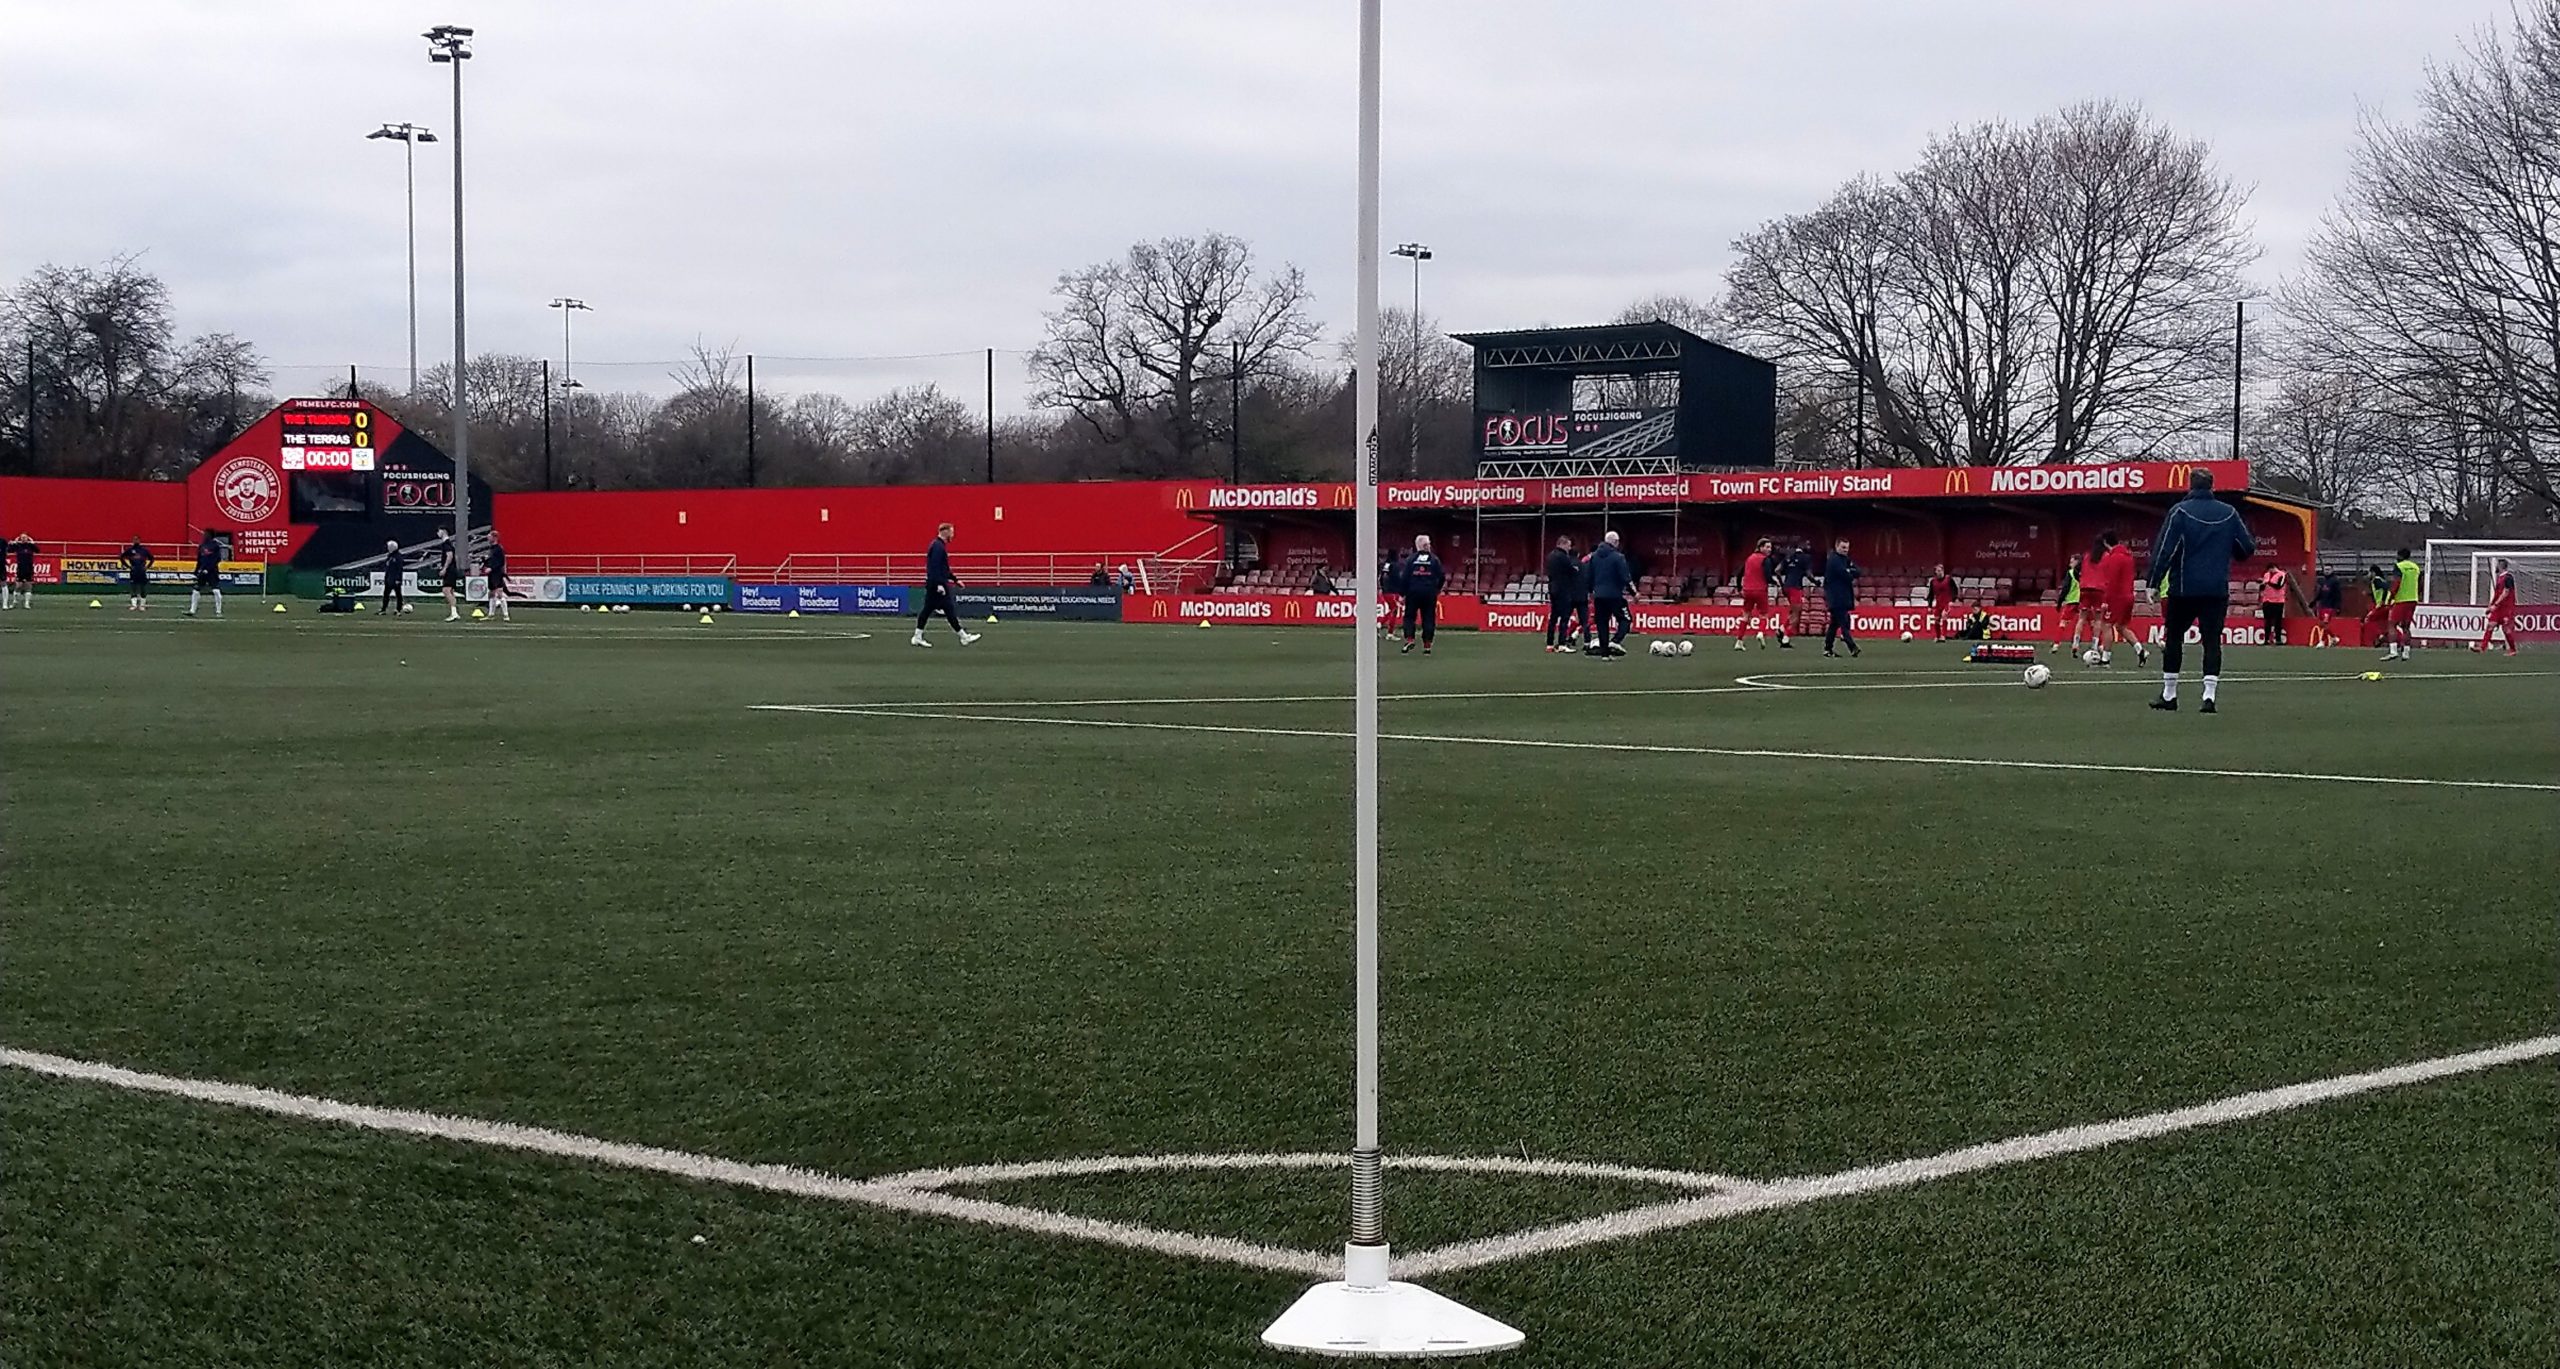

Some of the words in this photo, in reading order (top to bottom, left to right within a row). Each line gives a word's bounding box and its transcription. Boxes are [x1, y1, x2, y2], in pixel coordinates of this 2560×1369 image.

[355, 411, 367, 429] 0
[1484, 415, 1568, 446] FOCUS
[284, 433, 306, 444] THE
[307, 434, 351, 445] TERRAS
[356, 431, 368, 448] 0
[306, 451, 350, 467] 00:00
[1710, 478, 1754, 495] Town
[1759, 477, 1780, 494] FC
[1784, 475, 1839, 496] Family
[1842, 473, 1892, 491] Stand
[1990, 467, 2145, 491] McDonald's
[384, 483, 471, 507] FOCU
[1209, 487, 1318, 507] McDonald's
[1388, 486, 1442, 504] Proudly
[1445, 484, 1525, 502] Supporting
[1551, 482, 1599, 498] Hemel
[1604, 480, 1690, 499] Hempstead
[325, 575, 370, 587] Bottrills
[568, 583, 581, 595] SIR
[582, 583, 600, 595] MIKE
[601, 583, 635, 595] PENNING
[652, 583, 689, 596] WORKING
[690, 583, 706, 596] FOR
[707, 584, 724, 596] YOU
[741, 586, 759, 597] Hey!
[799, 586, 817, 597] Hey!
[858, 586, 876, 597] Hey!
[741, 597, 781, 607] Broadband
[799, 597, 839, 607] Broadband
[858, 597, 899, 607] Broadband
[1180, 601, 1272, 617] McDonald's
[1488, 611, 1545, 631] Proudly
[1635, 612, 1685, 629] Hemel
[1849, 614, 1894, 631] Town
[1900, 614, 1921, 631] FC
[1988, 614, 2042, 632] Stand
